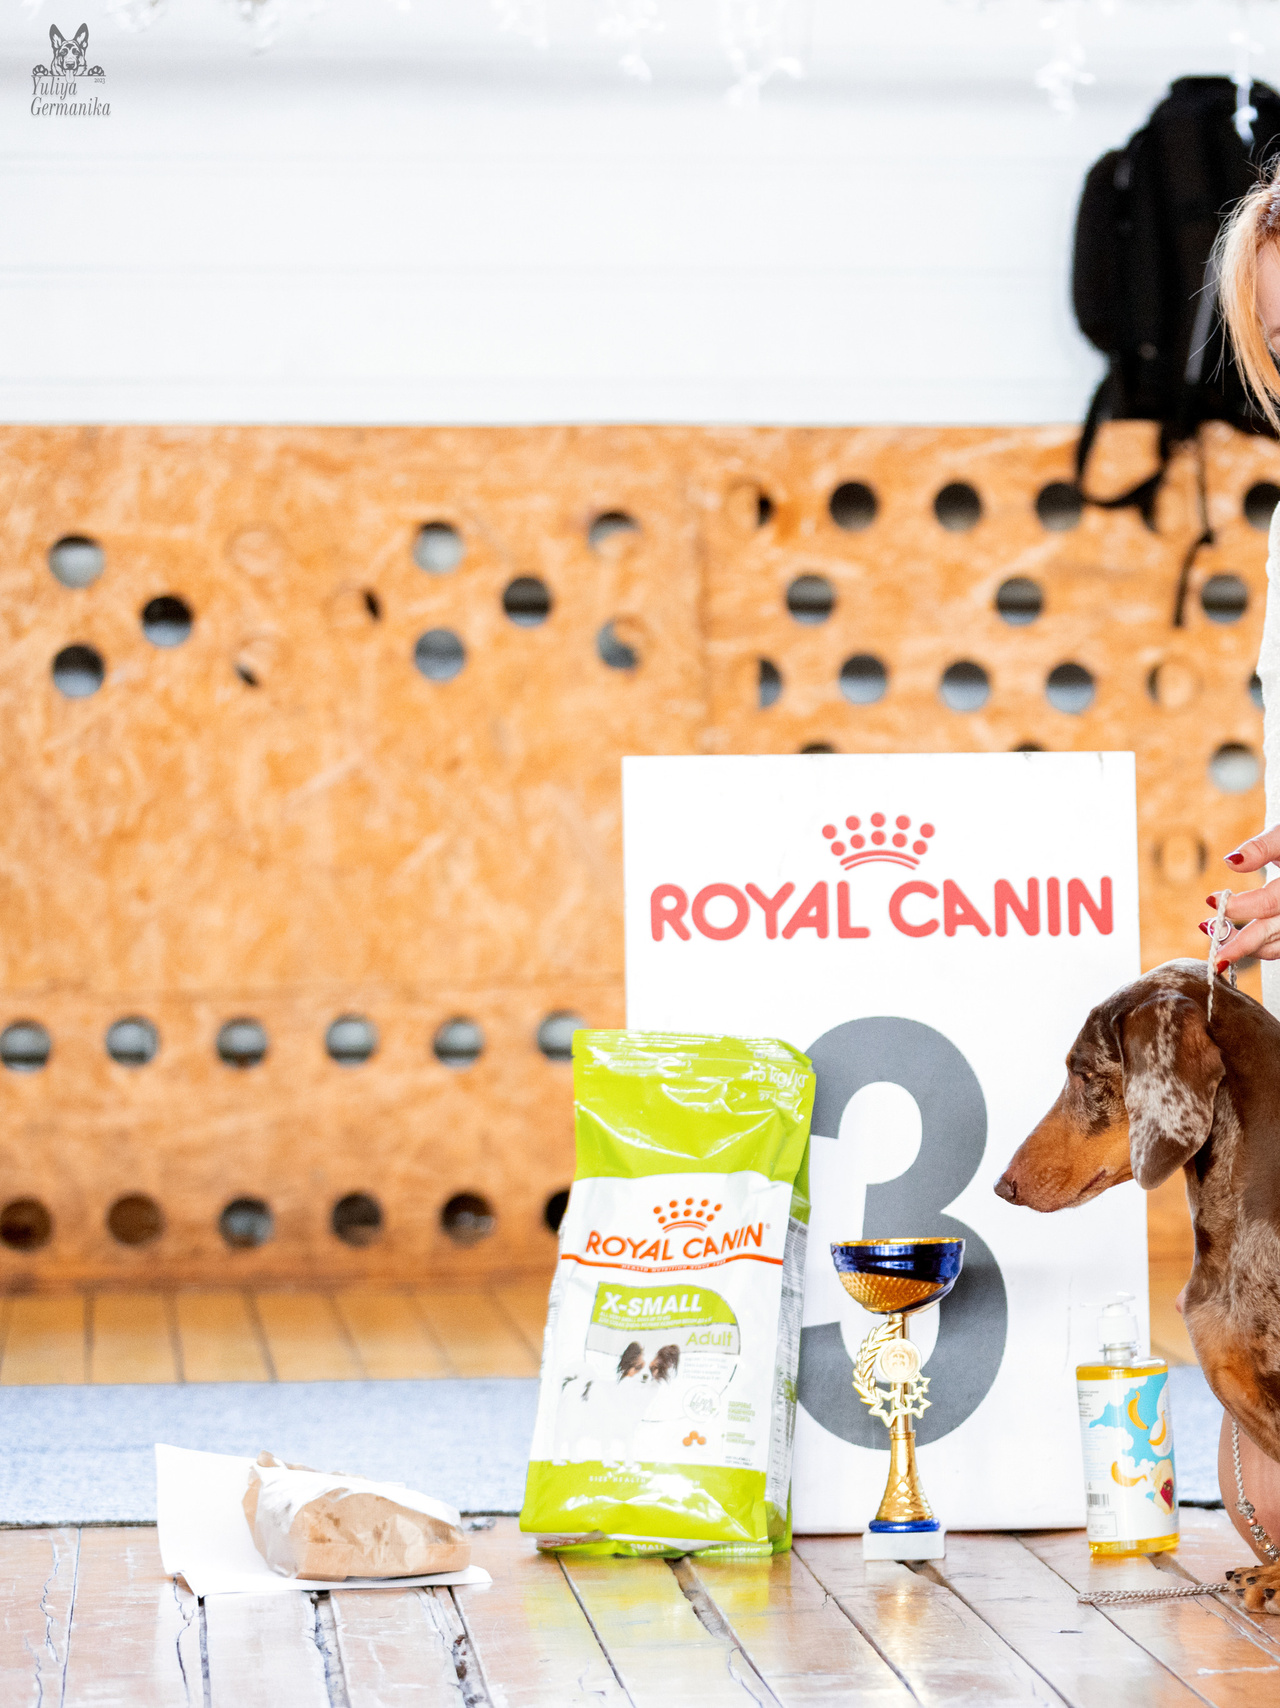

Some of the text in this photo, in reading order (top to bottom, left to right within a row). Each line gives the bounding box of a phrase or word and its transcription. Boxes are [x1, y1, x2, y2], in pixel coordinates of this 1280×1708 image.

[650, 876, 1114, 942] ROYAL CANIN
[585, 1230, 674, 1261] ROYAL
[682, 1222, 763, 1259] CANIN
[799, 1016, 1009, 1450] 3
[601, 1291, 702, 1317] X-SMALL
[685, 1331, 733, 1347] Adult
[588, 1475, 608, 1483] SIZE
[612, 1476, 647, 1484] HEALTH
